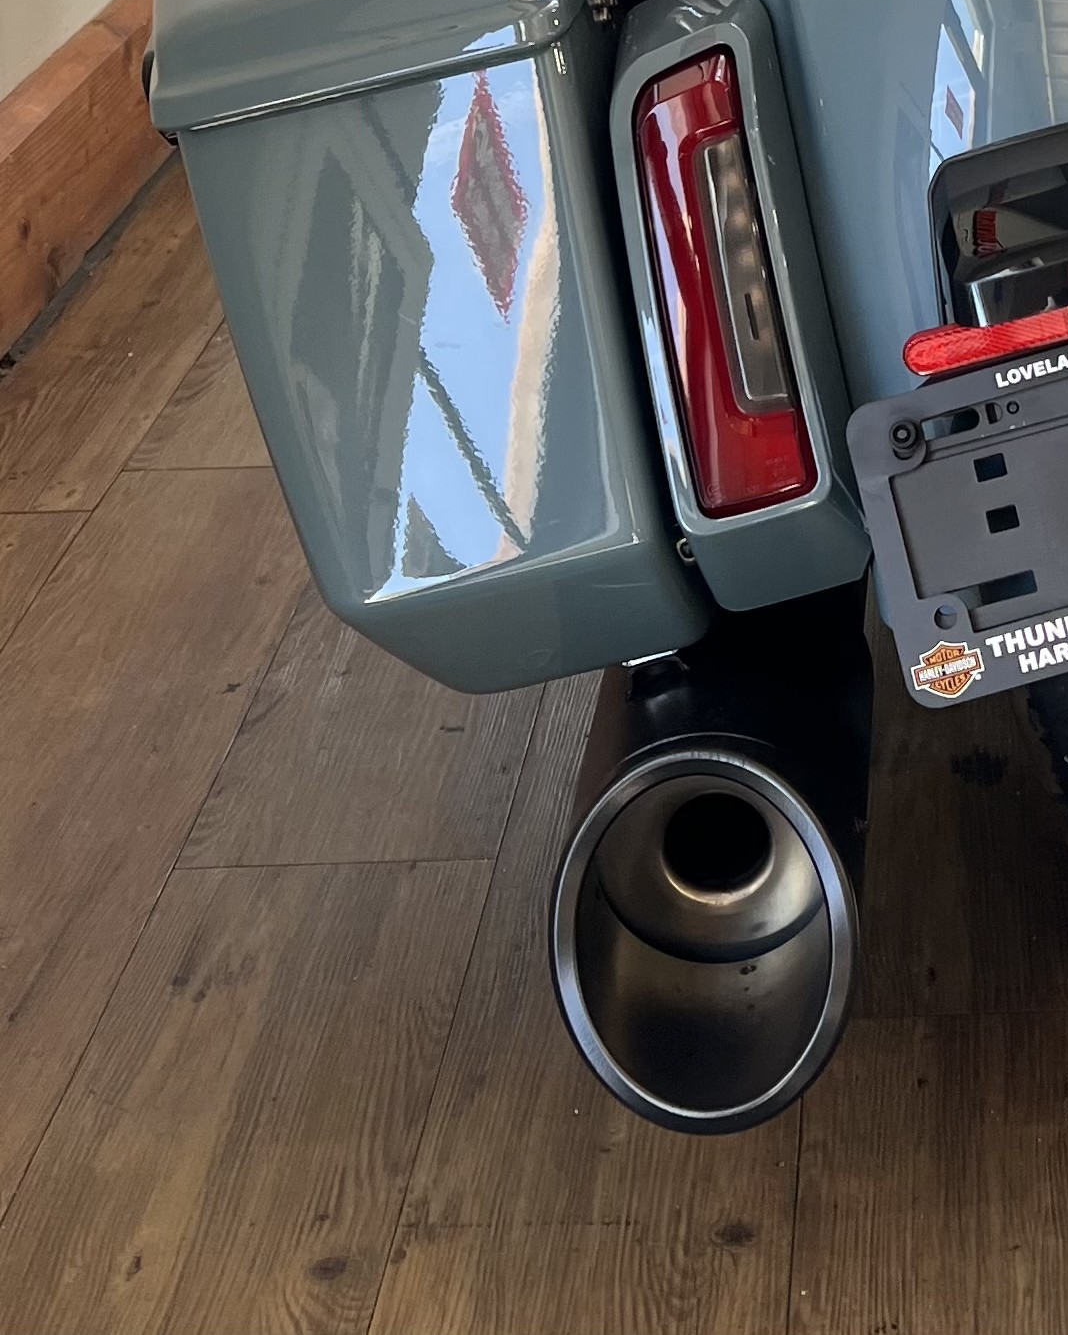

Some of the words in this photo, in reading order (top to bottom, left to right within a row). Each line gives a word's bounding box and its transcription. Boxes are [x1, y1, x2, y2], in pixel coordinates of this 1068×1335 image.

[929, 648, 960, 664] MOTOR
[918, 656, 977, 682] HARLEY-DAVIDSON
[935, 673, 966, 691] CYCLES
